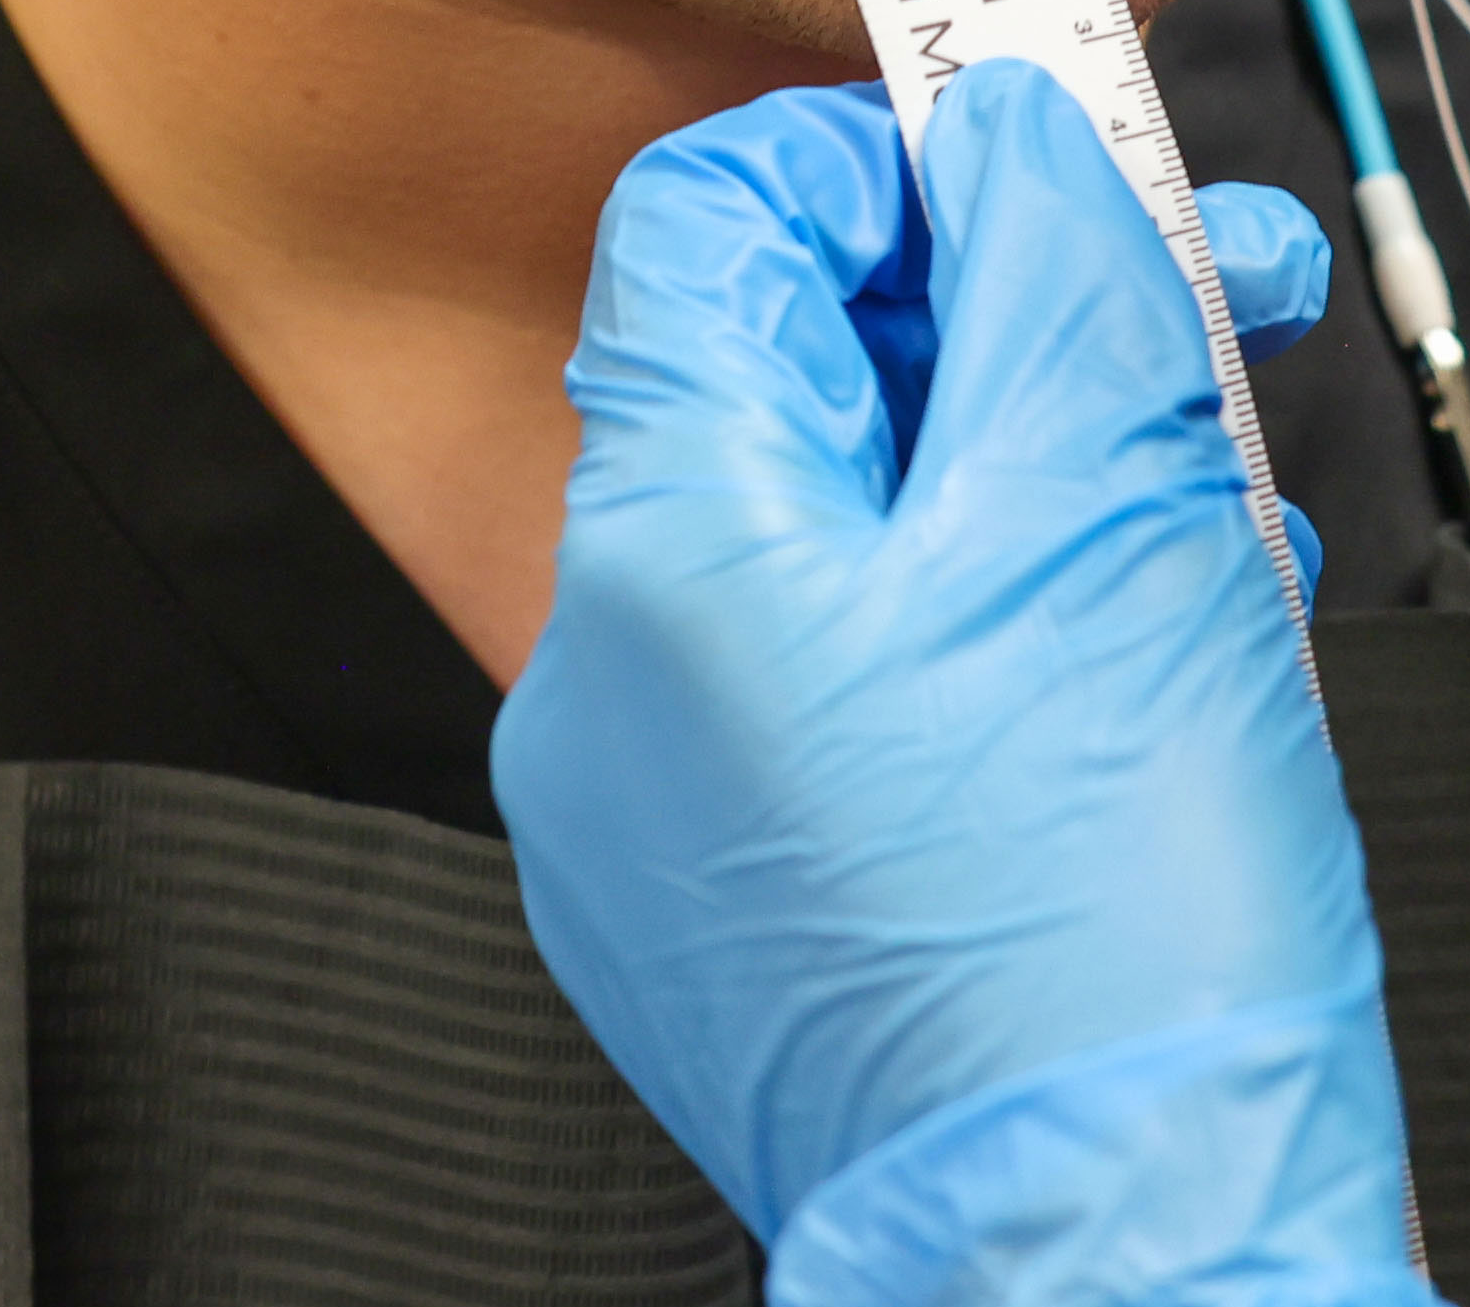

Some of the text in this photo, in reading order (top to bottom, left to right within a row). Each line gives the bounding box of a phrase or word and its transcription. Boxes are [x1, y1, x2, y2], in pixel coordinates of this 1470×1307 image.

[909, 19, 965, 105] M
[1073, 18, 1094, 35] 3
[1109, 117, 1128, 133] 4
